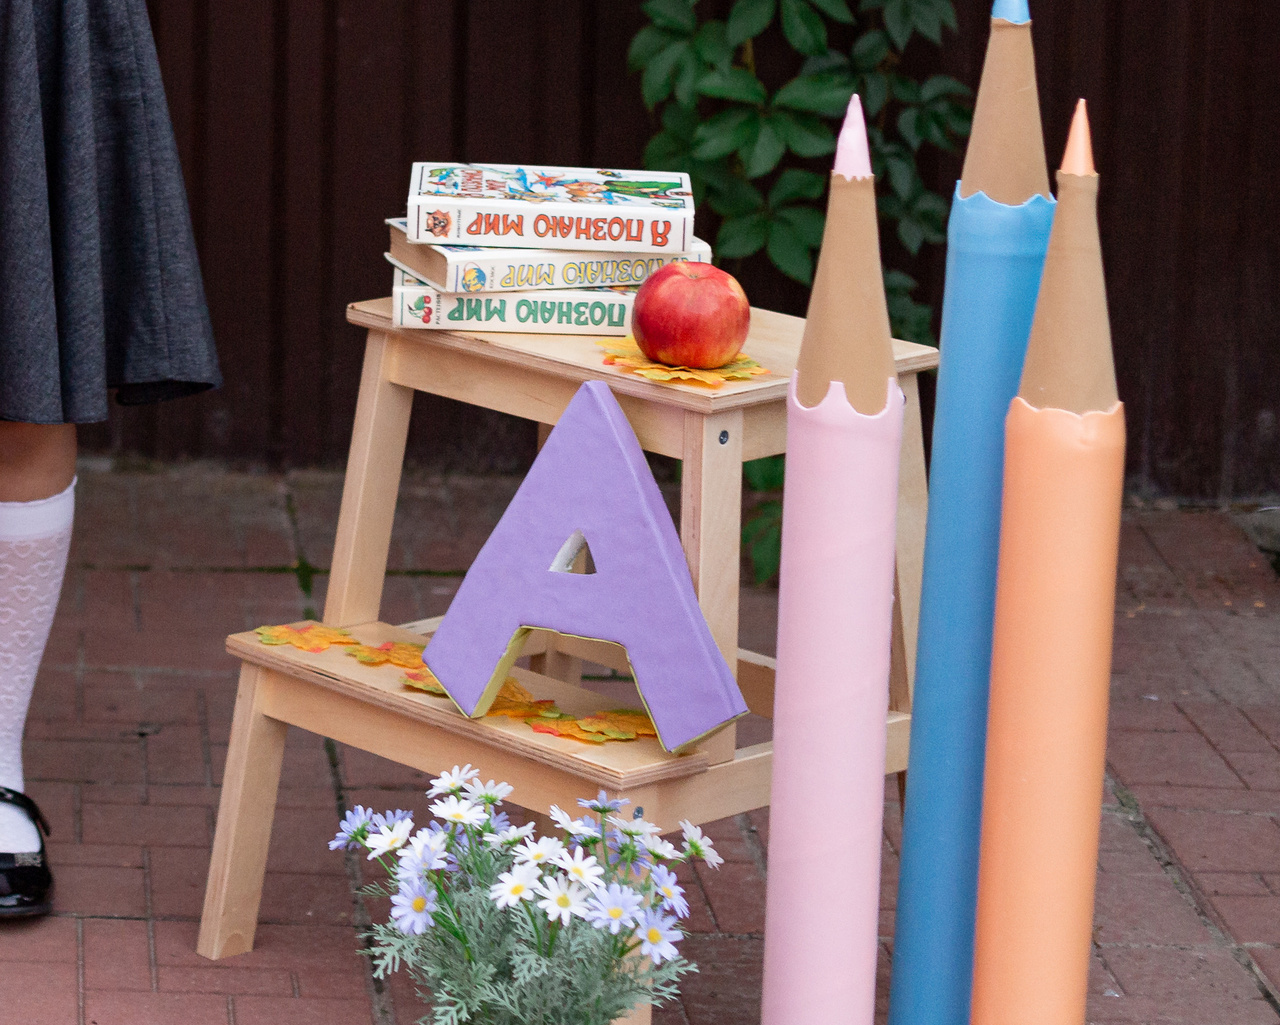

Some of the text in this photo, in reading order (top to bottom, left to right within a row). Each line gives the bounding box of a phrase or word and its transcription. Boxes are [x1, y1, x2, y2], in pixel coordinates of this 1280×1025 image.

[466, 211, 672, 247] Я ПОЗНАЮ МИР
[500, 263, 556, 288] МИР
[447, 296, 627, 327] ПОЗНАЮ МИР
